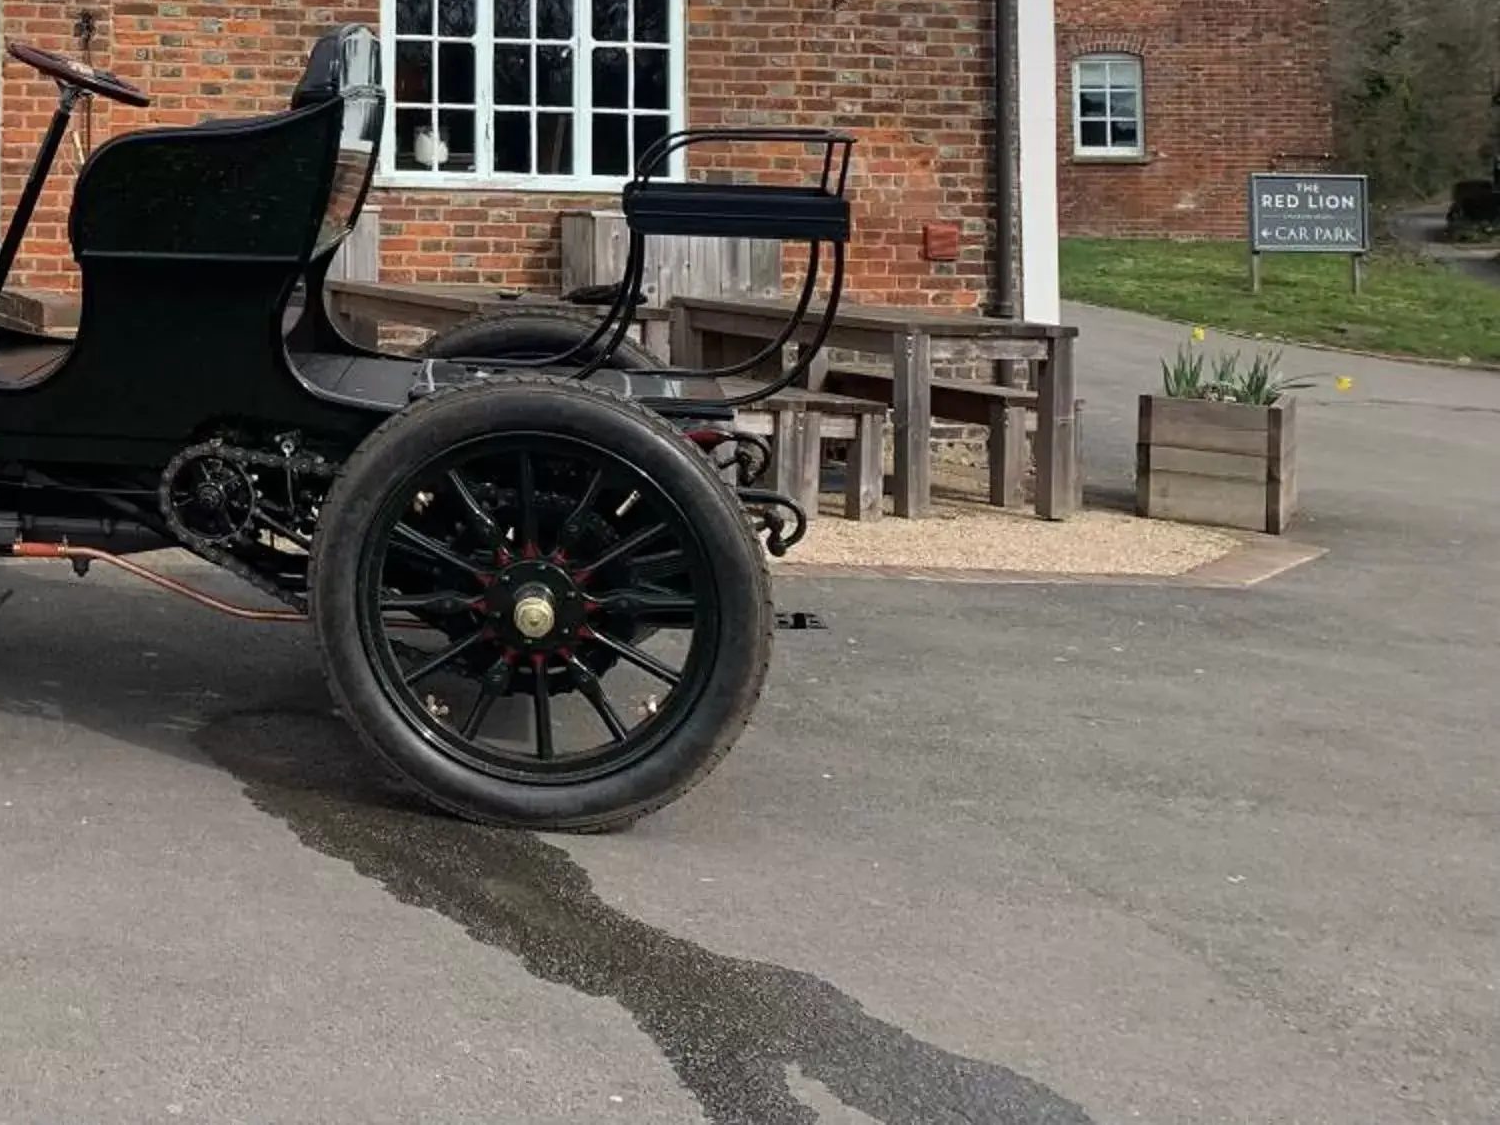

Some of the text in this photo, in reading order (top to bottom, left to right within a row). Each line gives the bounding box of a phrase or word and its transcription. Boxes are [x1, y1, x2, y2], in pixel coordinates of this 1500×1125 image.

[1295, 182, 1321, 194] THE
[1261, 194, 1355, 209] RED LION
[1275, 227, 1356, 242] CAR PARK
